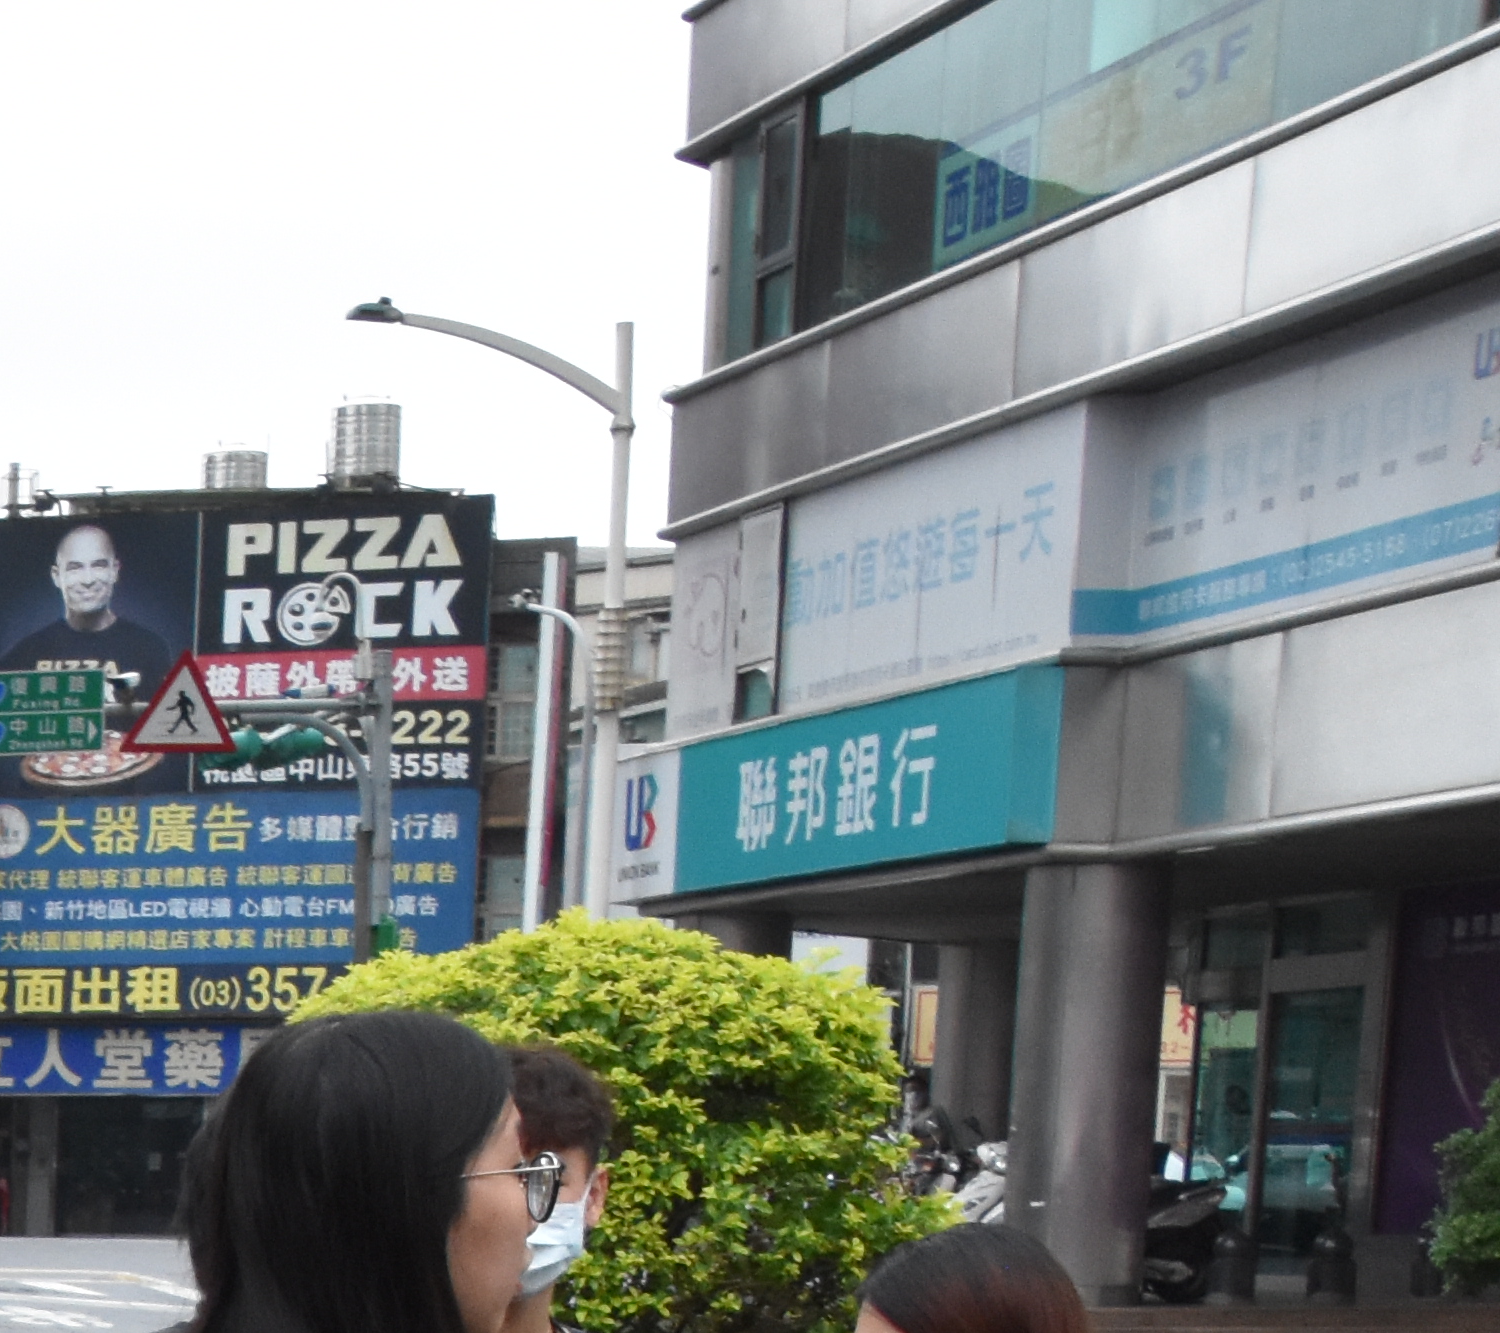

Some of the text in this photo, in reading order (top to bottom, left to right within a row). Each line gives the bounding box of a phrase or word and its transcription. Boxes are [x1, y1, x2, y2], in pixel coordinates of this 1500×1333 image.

[227, 513, 462, 577] PIZZA
[9, 716, 86, 736] 中山路
[736, 725, 938, 853] 聯邦銀行
[35, 803, 253, 855] 大器廣告
